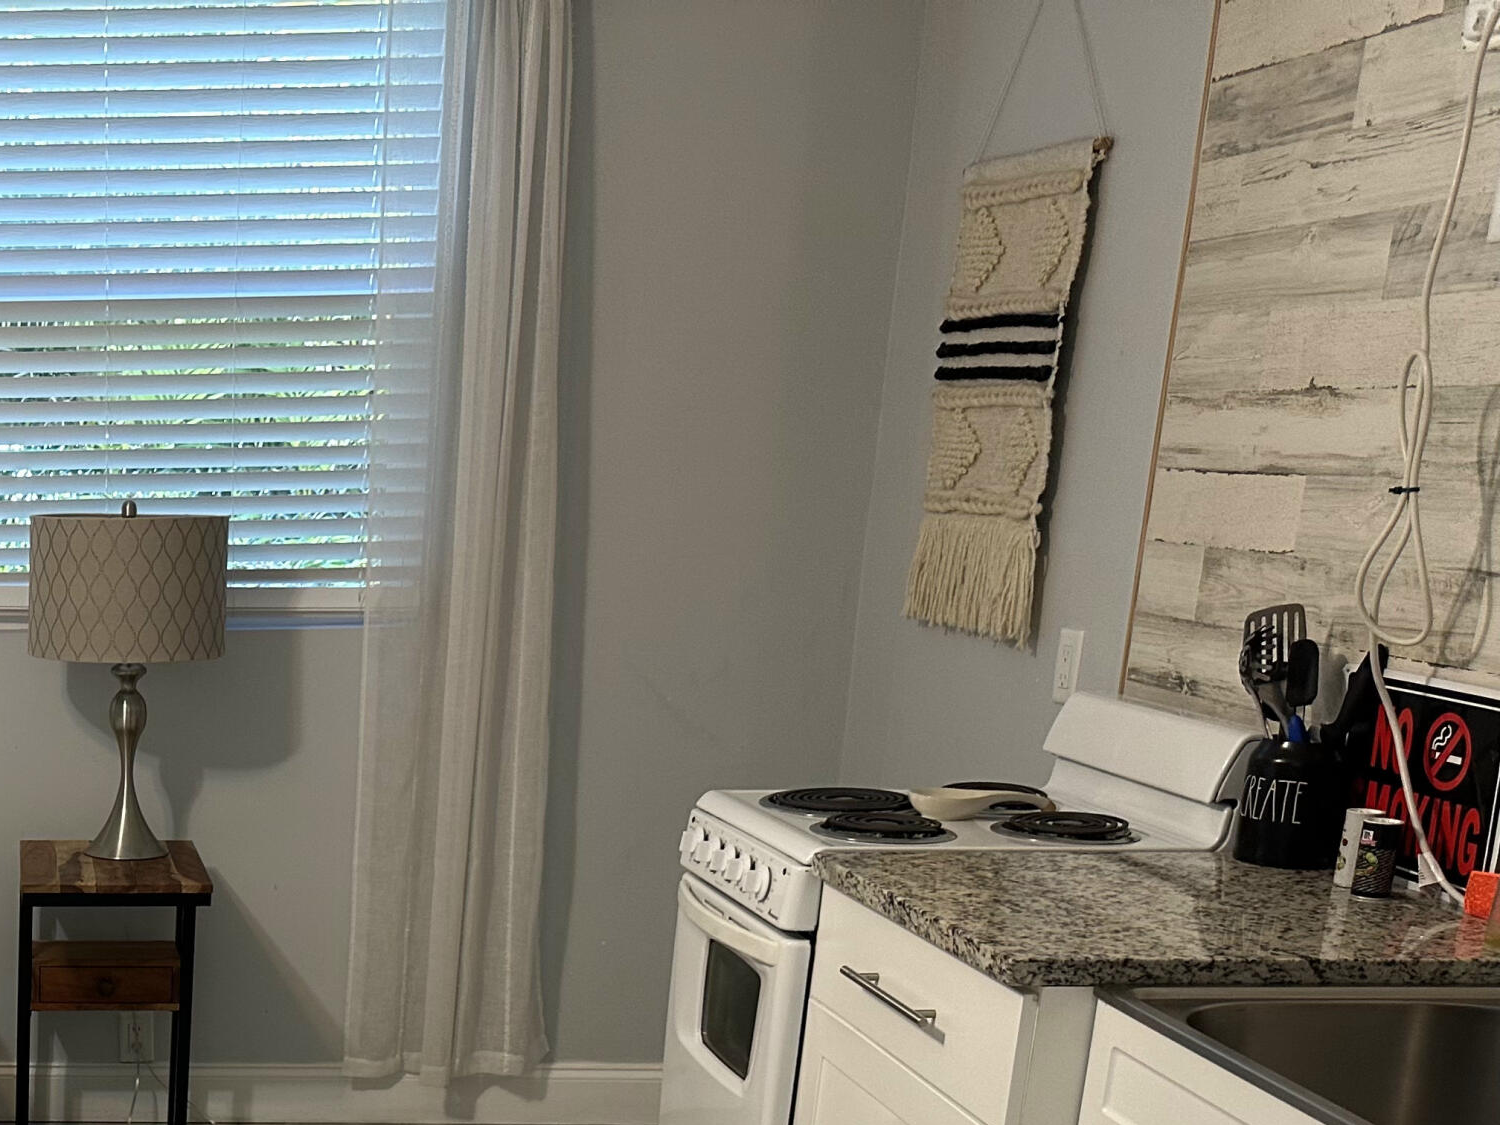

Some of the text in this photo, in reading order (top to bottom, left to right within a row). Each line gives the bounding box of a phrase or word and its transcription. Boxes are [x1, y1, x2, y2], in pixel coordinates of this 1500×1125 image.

[1369, 703, 1415, 775] NO
[1240, 774, 1309, 825] CREATE
[1352, 776, 1482, 877] OKING
